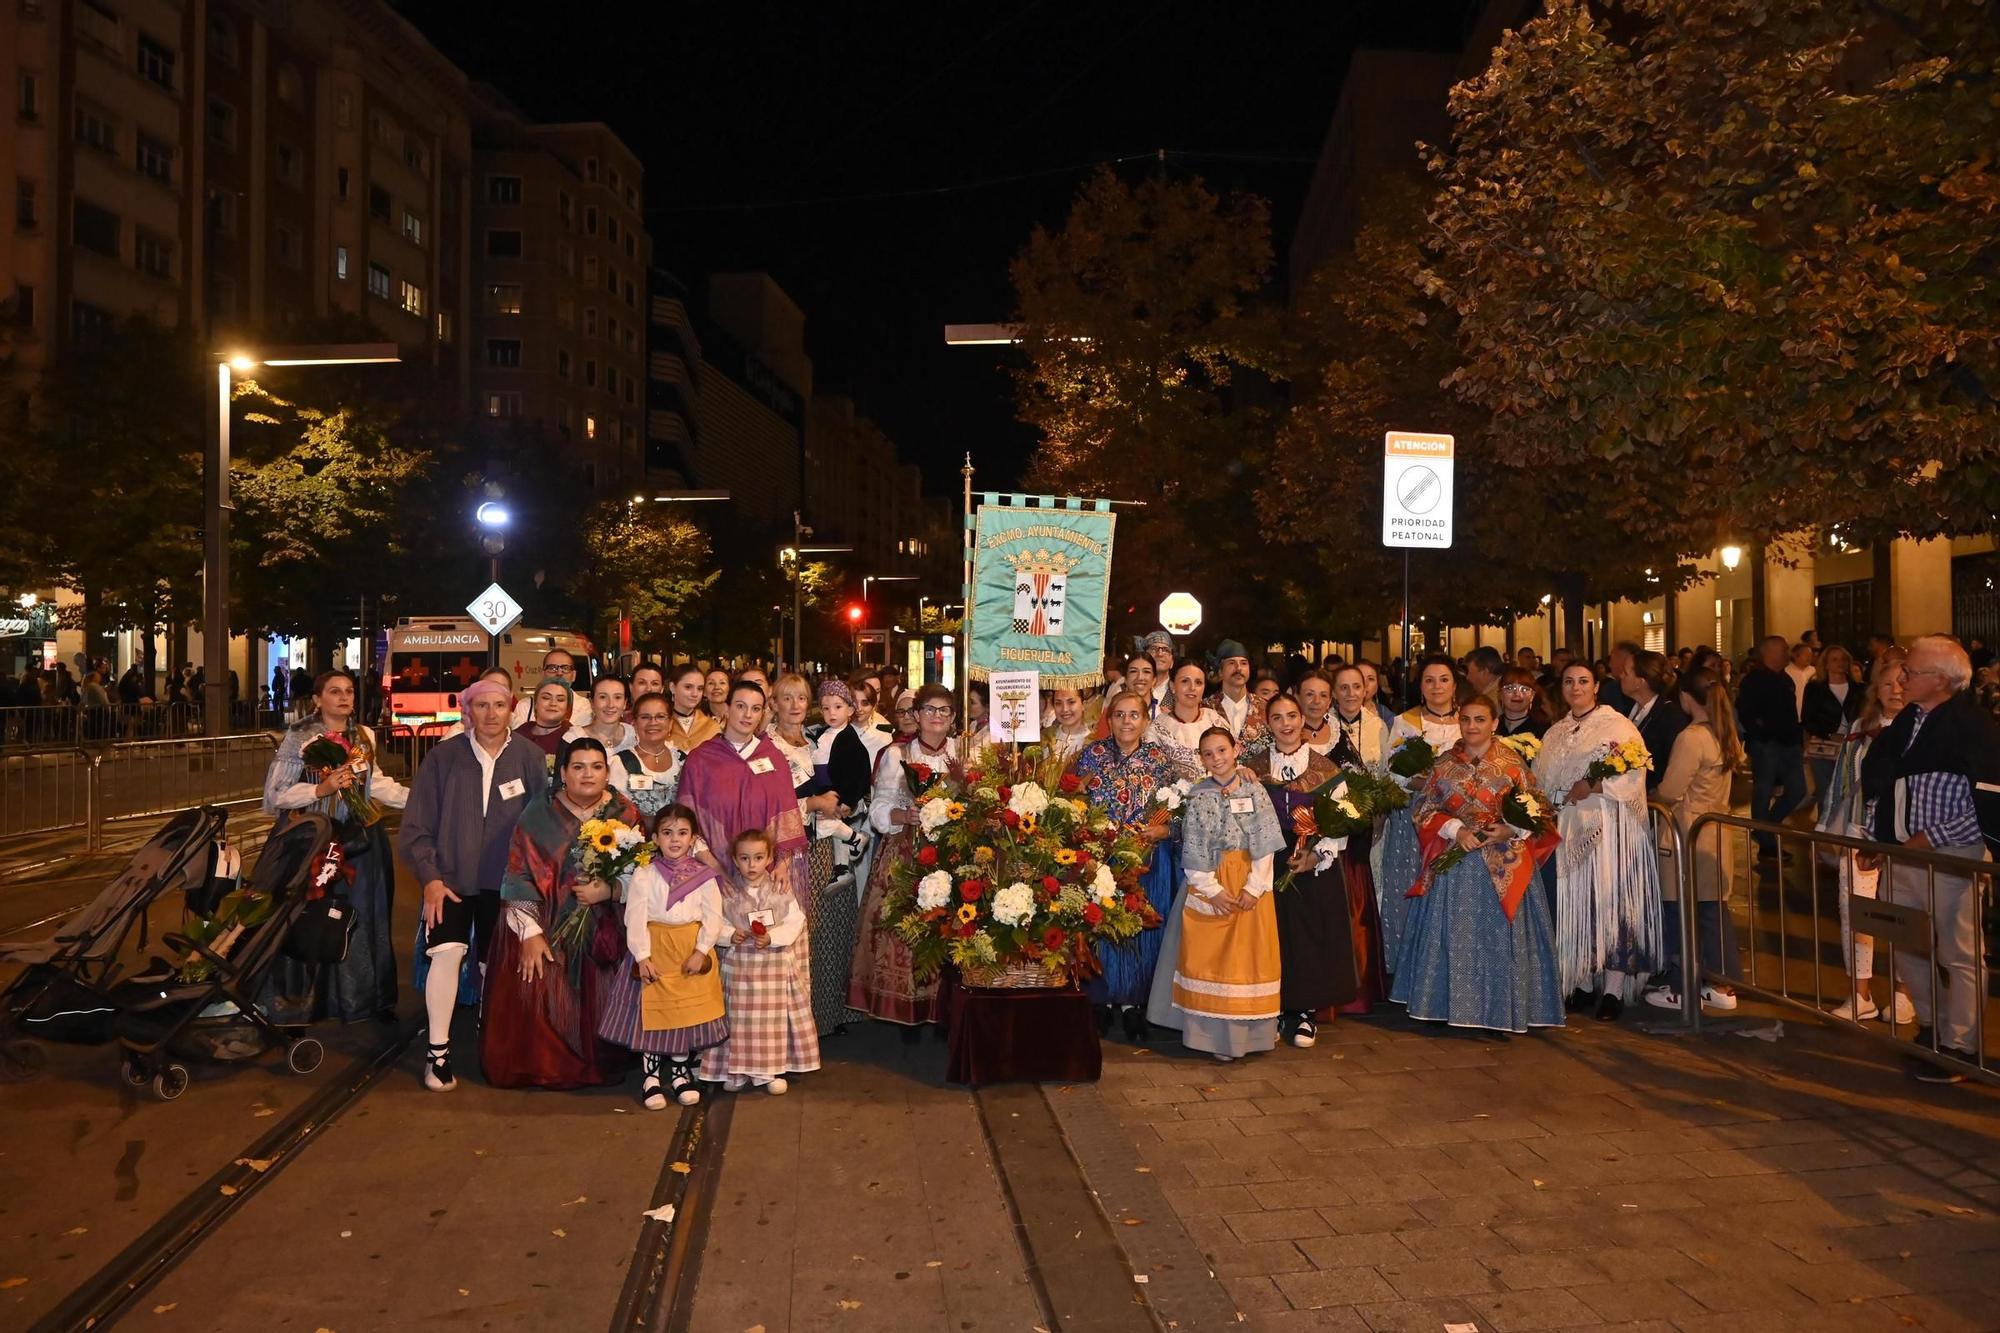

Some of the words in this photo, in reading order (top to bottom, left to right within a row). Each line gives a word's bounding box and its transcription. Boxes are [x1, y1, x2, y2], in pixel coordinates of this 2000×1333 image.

[1391, 518, 1446, 528] PRIORIDAD
[988, 527, 1025, 549] EXCMO.
[1027, 525, 1102, 555] AYUNTAMIENTO
[1391, 531, 1444, 541] PEATONAL
[482, 601, 507, 618] 30
[403, 635, 480, 645] AMBULANCIA
[1000, 648, 1073, 665] FIGUERUELAS
